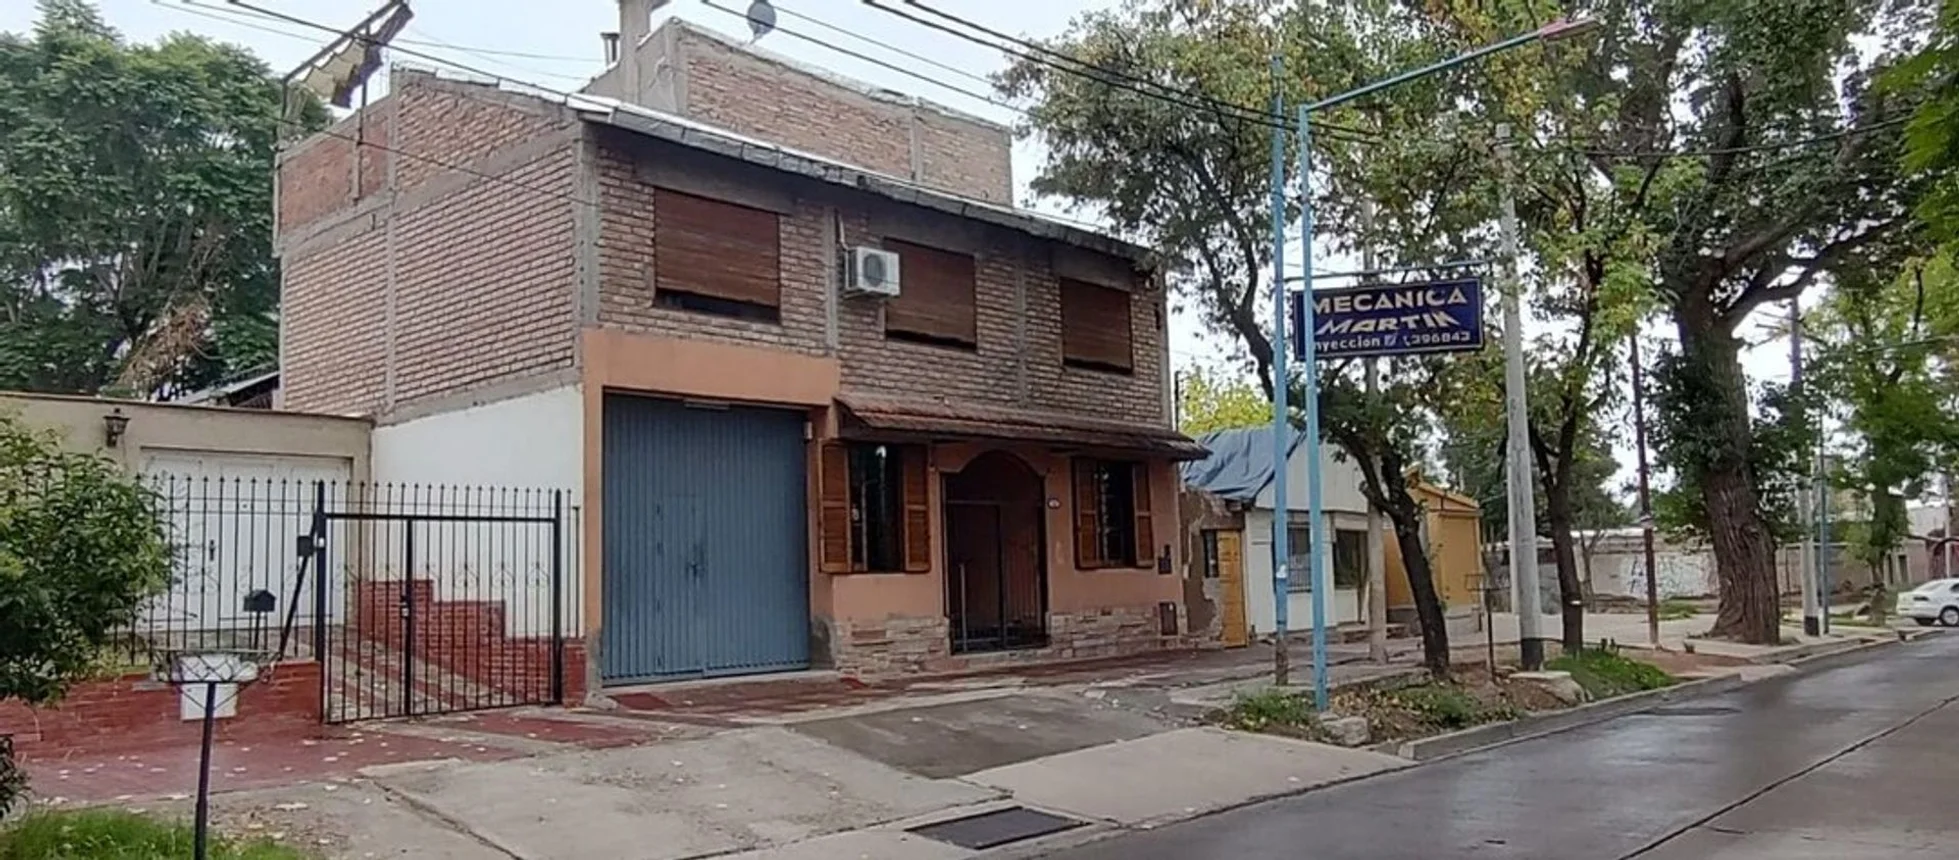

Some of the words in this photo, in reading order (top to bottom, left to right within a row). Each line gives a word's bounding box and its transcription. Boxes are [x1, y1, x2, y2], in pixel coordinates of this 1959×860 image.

[1312, 287, 1467, 315] MECANICA
[1315, 311, 1461, 335] MARTIN
[1313, 335, 1381, 352] nyeccion
